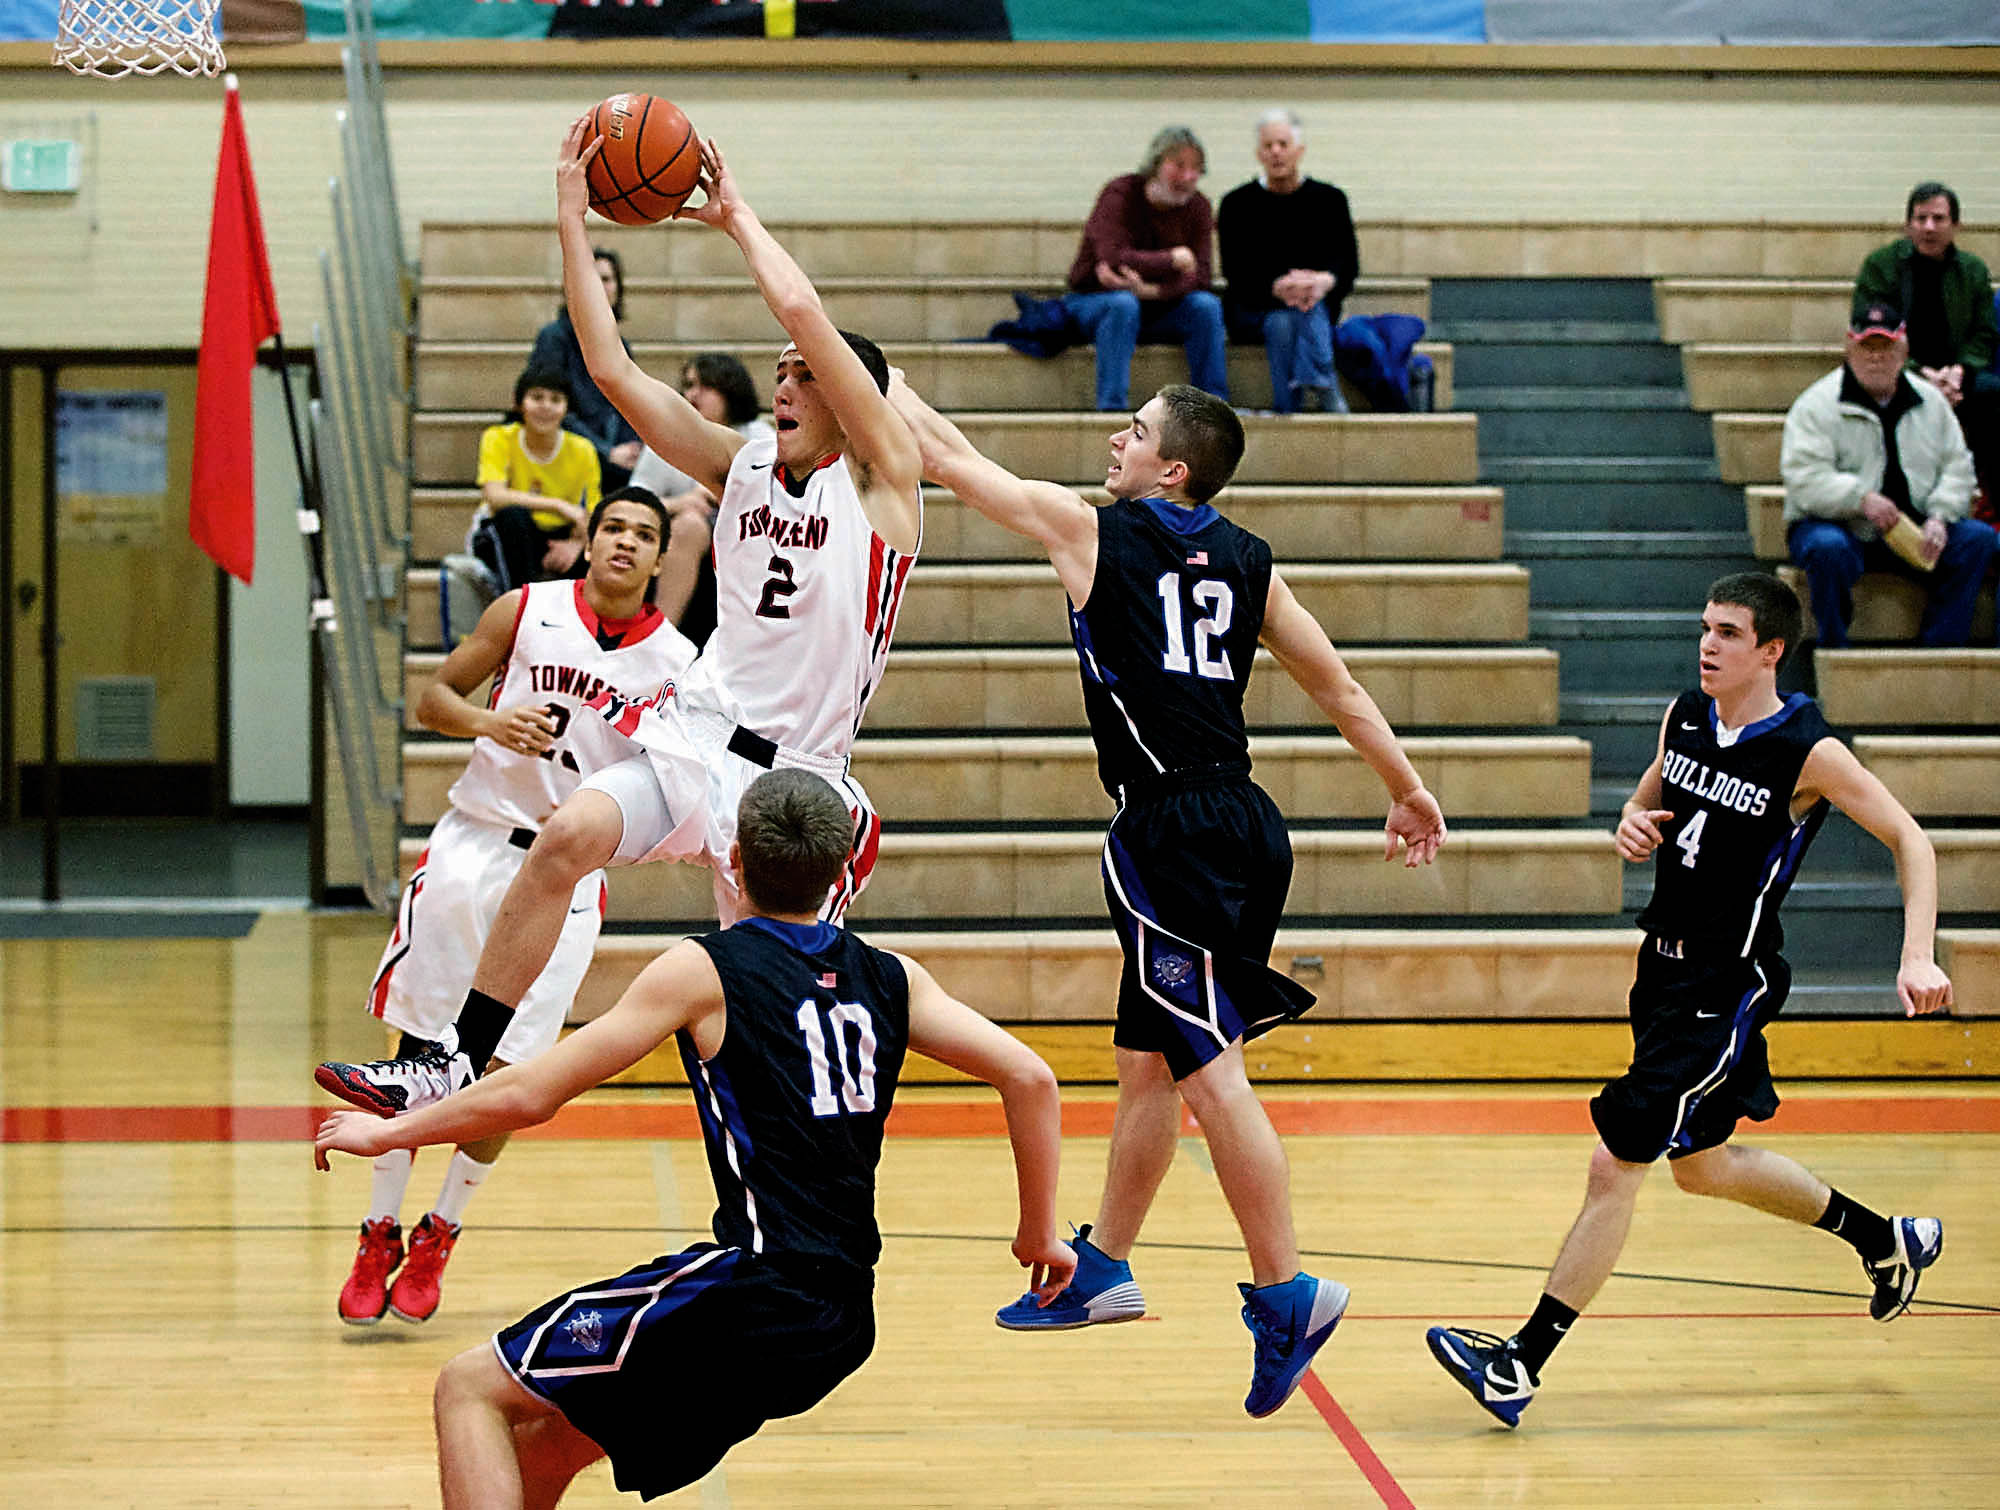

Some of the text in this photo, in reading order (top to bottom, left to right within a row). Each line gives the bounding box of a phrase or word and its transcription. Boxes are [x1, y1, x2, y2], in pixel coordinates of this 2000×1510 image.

[755, 554, 798, 619] 2
[1157, 570, 1235, 681] 12
[1661, 749, 1771, 817] BULLDOGS
[1676, 809, 1708, 869] 4
[794, 998, 877, 1117] 10
